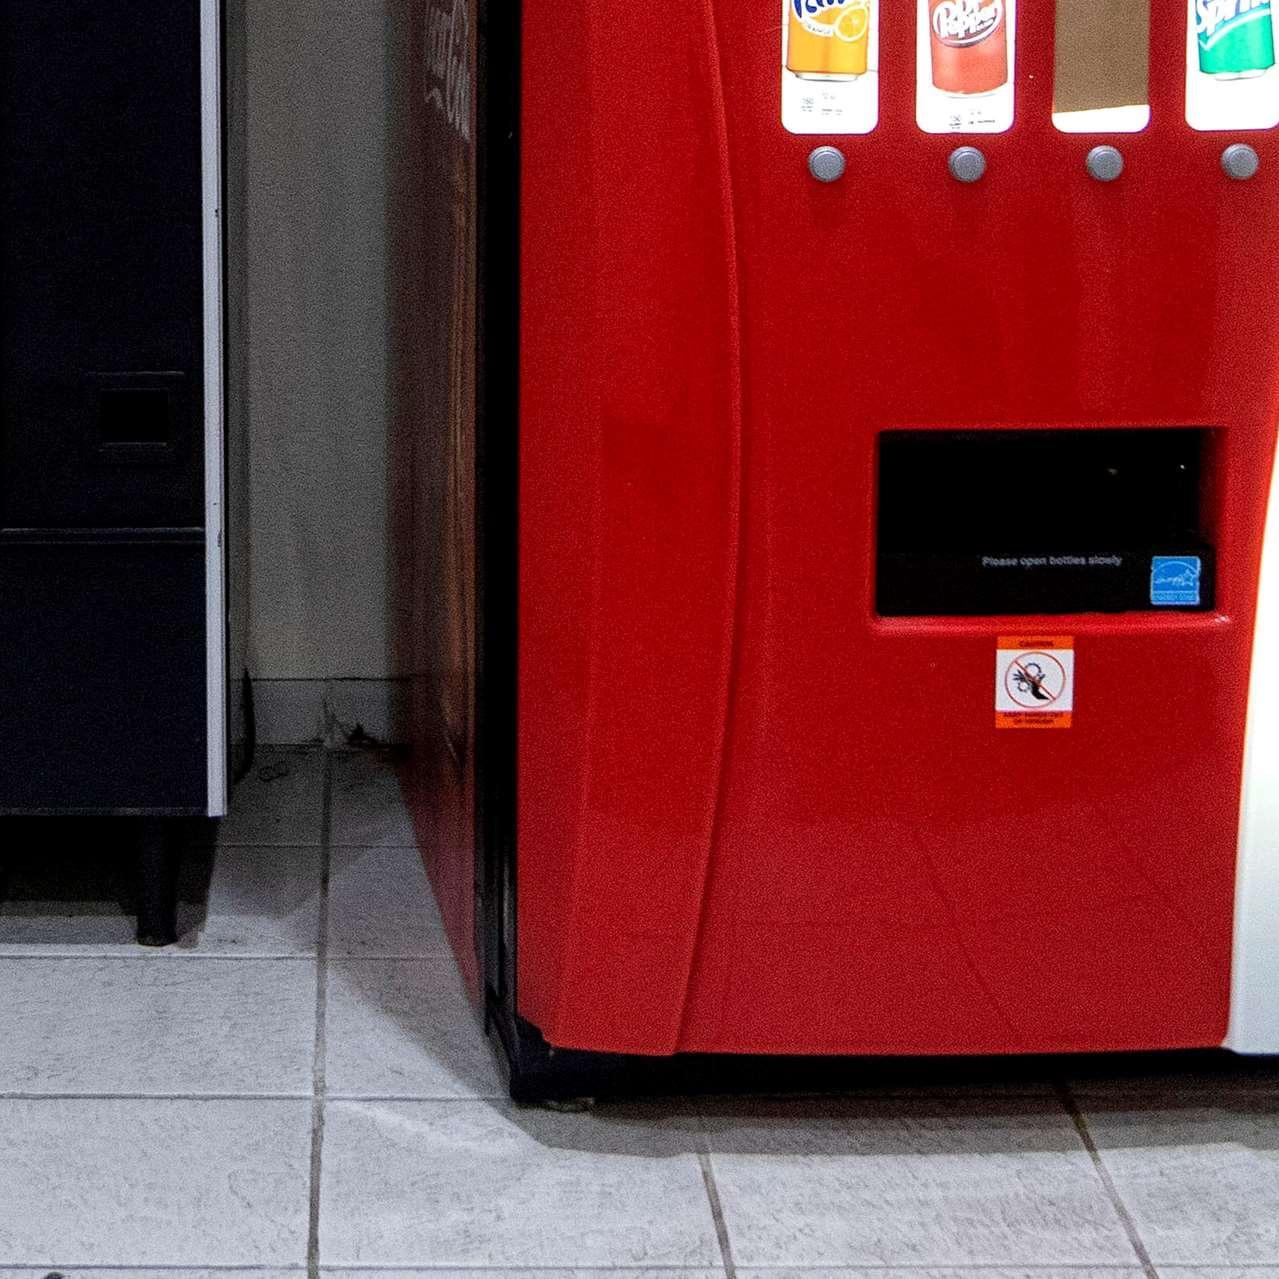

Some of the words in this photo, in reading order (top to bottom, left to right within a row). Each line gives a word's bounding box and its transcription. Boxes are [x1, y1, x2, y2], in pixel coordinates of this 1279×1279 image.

[982, 556, 1017, 567] Please
[1020, 558, 1047, 569] open
[1050, 555, 1086, 566] bottles
[1088, 555, 1122, 568] slowly
